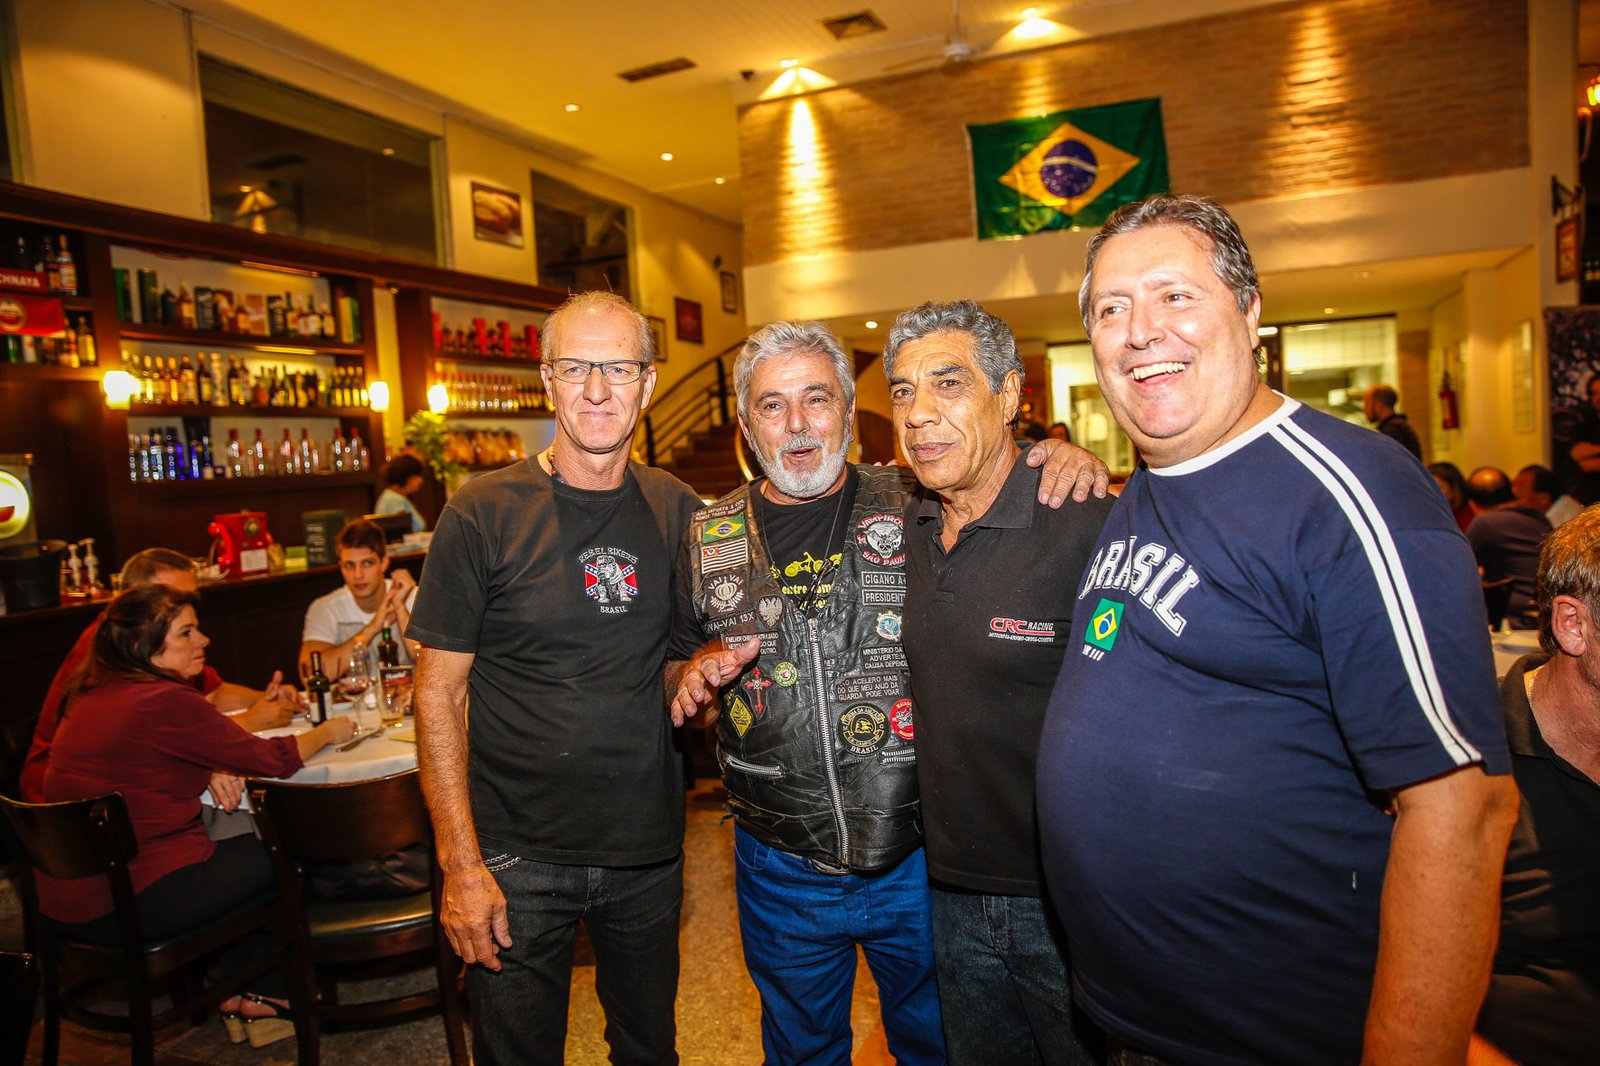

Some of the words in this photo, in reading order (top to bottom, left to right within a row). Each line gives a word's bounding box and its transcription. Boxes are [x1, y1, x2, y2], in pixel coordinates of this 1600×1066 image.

[578, 547, 607, 563] REBEL
[607, 547, 639, 564] BIKERS
[862, 551, 881, 563] SÃO
[883, 553, 906, 566] PAUL
[708, 576, 722, 590] VAI
[729, 574, 744, 585] VAI
[865, 574, 895, 584] CIGANO
[1078, 536, 1200, 637] BRASIL
[865, 593, 906, 603] PRESIDENT
[600, 606, 628, 614] BRASIL
[740, 611, 755, 623] 13X
[990, 617, 1028, 634] CRC
[1027, 621, 1054, 631] RACING
[852, 676, 881, 685] ACELERO
[874, 682, 889, 690] ANJO
[866, 690, 882, 698] PODE
[851, 745, 878, 754] BRASIL
